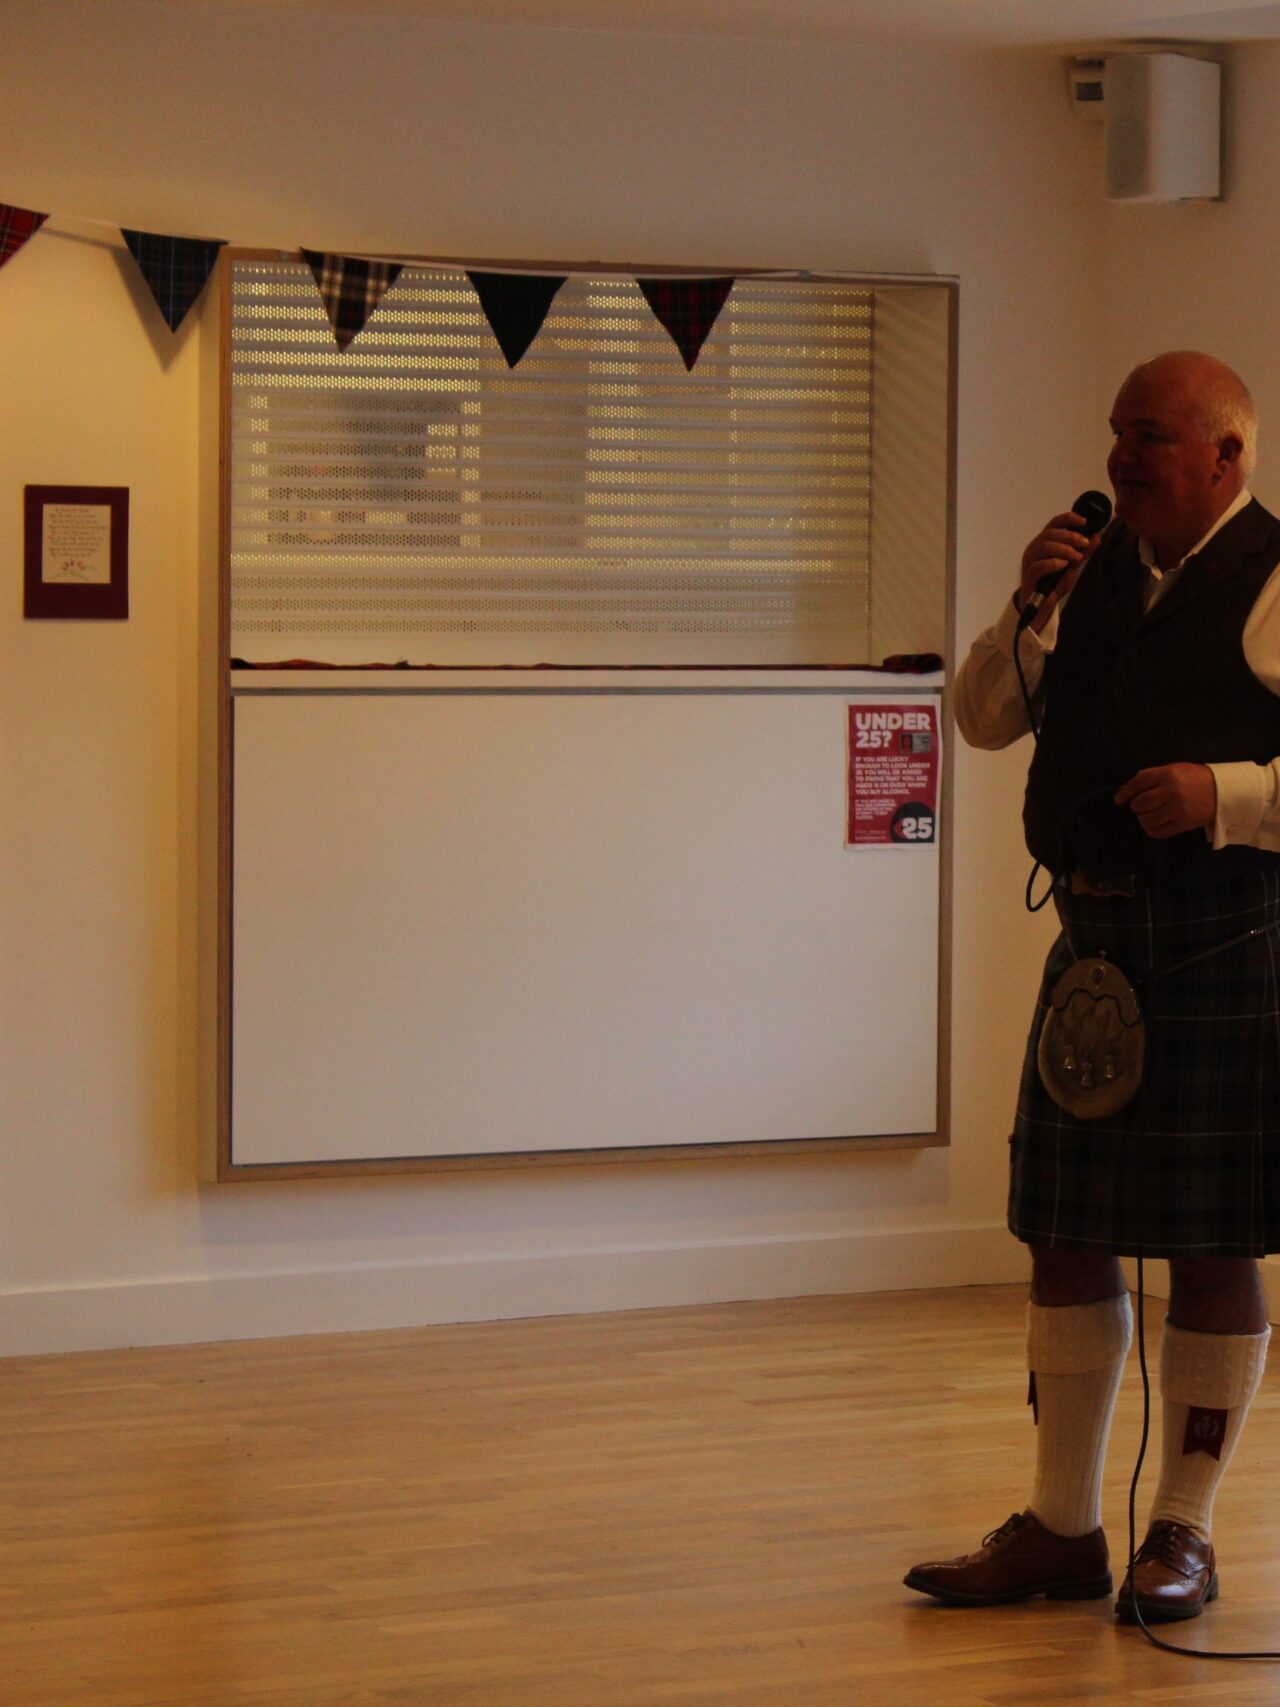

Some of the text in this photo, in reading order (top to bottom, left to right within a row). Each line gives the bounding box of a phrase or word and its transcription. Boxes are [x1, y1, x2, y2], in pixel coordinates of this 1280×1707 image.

[855, 712, 931, 730] UNDER
[855, 730, 893, 748] 25?
[902, 817, 932, 839] 25
